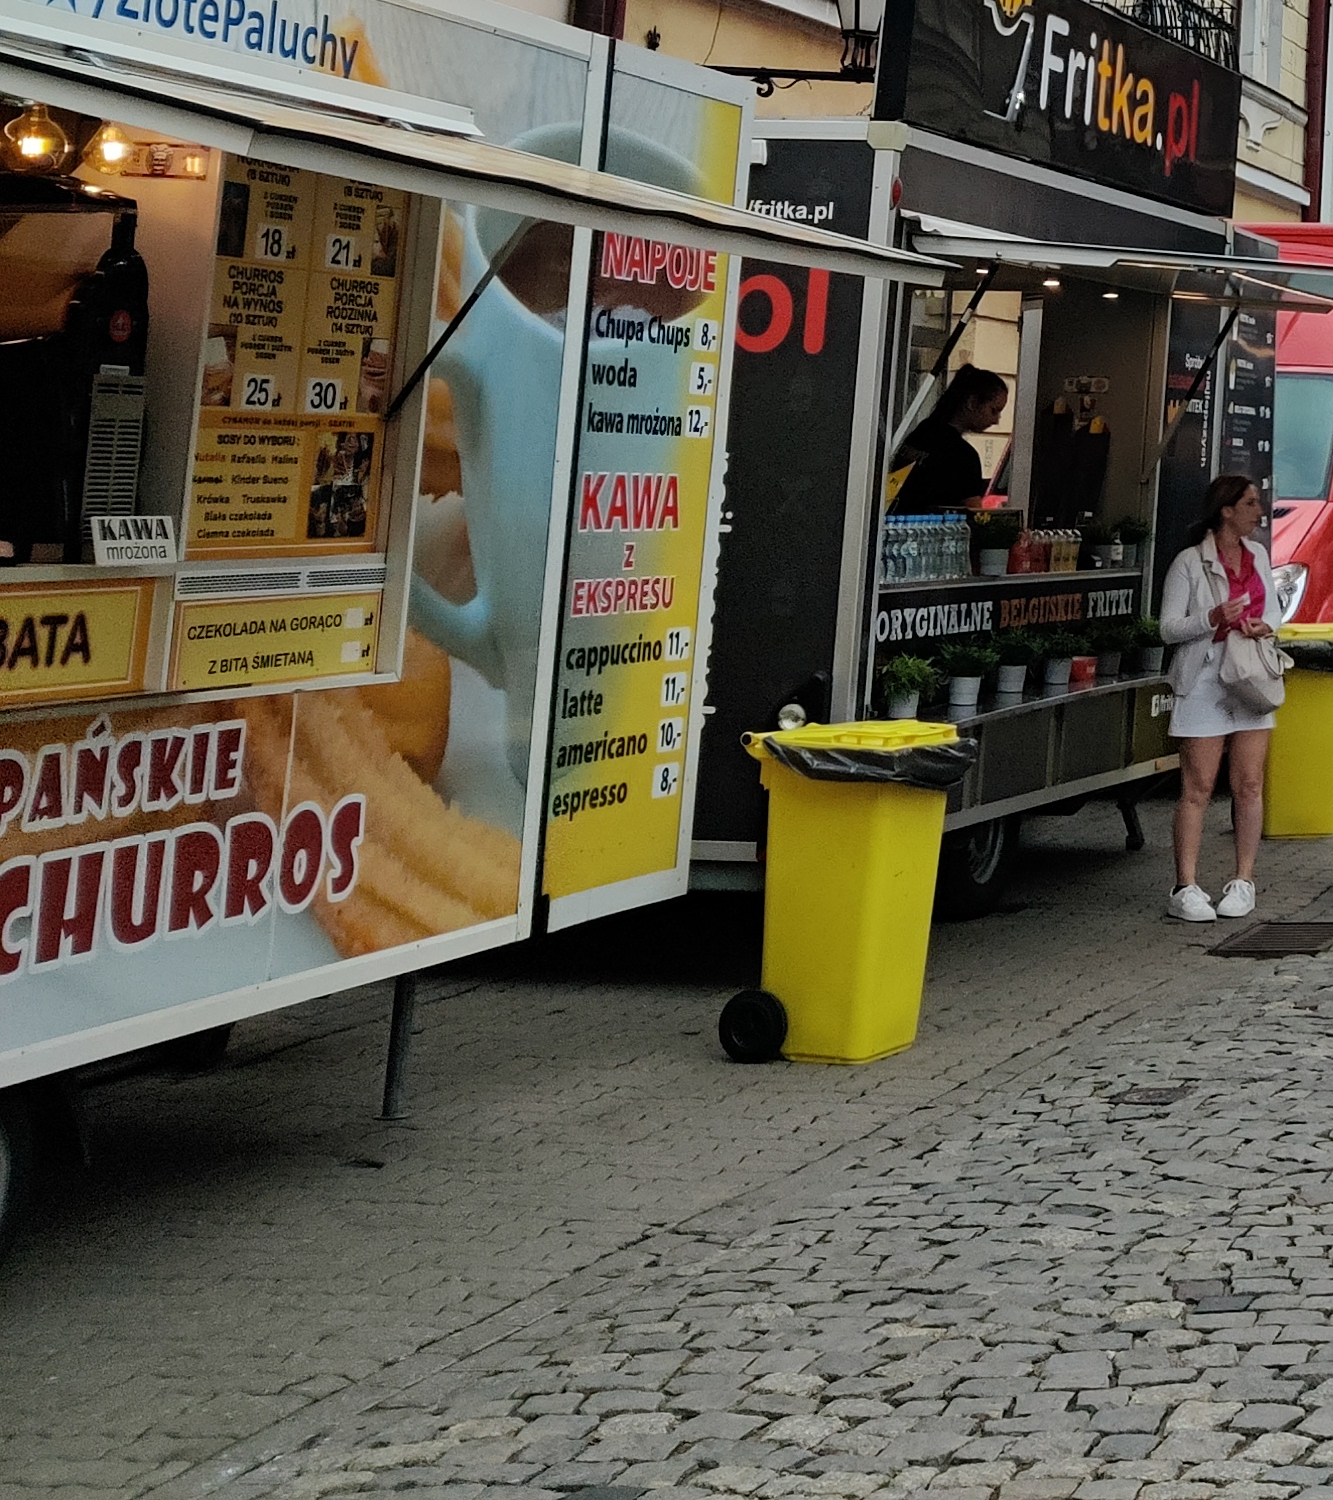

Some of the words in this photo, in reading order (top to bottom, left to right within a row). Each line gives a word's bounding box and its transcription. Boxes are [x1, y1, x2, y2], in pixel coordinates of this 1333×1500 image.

[1040, 13, 1200, 178] Fritka.pl
[261, 228, 282, 258] 18
[331, 238, 350, 266] 21
[228, 265, 284, 284] CHURROS
[601, 231, 718, 294] NAPOJE
[232, 281, 278, 298] PORCJA
[330, 277, 380, 295] CHURROS
[333, 292, 374, 308] PORCJA
[223, 294, 239, 310] NA
[243, 298, 284, 314] WYNOS
[326, 306, 379, 323] RODZINNA
[595, 310, 644, 348] Chupa
[648, 315, 690, 353] Chups
[592, 358, 637, 387] woda
[246, 377, 270, 406] 25
[310, 382, 336, 409] 30
[587, 403, 624, 433] kawa
[626, 407, 682, 437] mrożona
[217, 434, 241, 445] SOSY
[578, 472, 680, 533] KAWA
[97, 518, 170, 541] KAWA
[106, 541, 168, 560] mrożona
[571, 576, 676, 618] EKSPRESU
[187, 619, 266, 641] CZEKOLADA
[269, 618, 287, 634] NA
[290, 613, 343, 634] GORĄCO
[875, 601, 994, 643] ORYGINALNE
[1087, 588, 1134, 619] FRITKI
[208, 659, 217, 675] Z
[219, 656, 250, 674] BITĄ
[251, 650, 315, 671] ŚMIETANĄ
[566, 634, 663, 677] cappuccino
[561, 687, 604, 720] latte
[556, 730, 648, 770] americano
[552, 781, 629, 822] espresso
[0, 797, 366, 978] CHURROS
